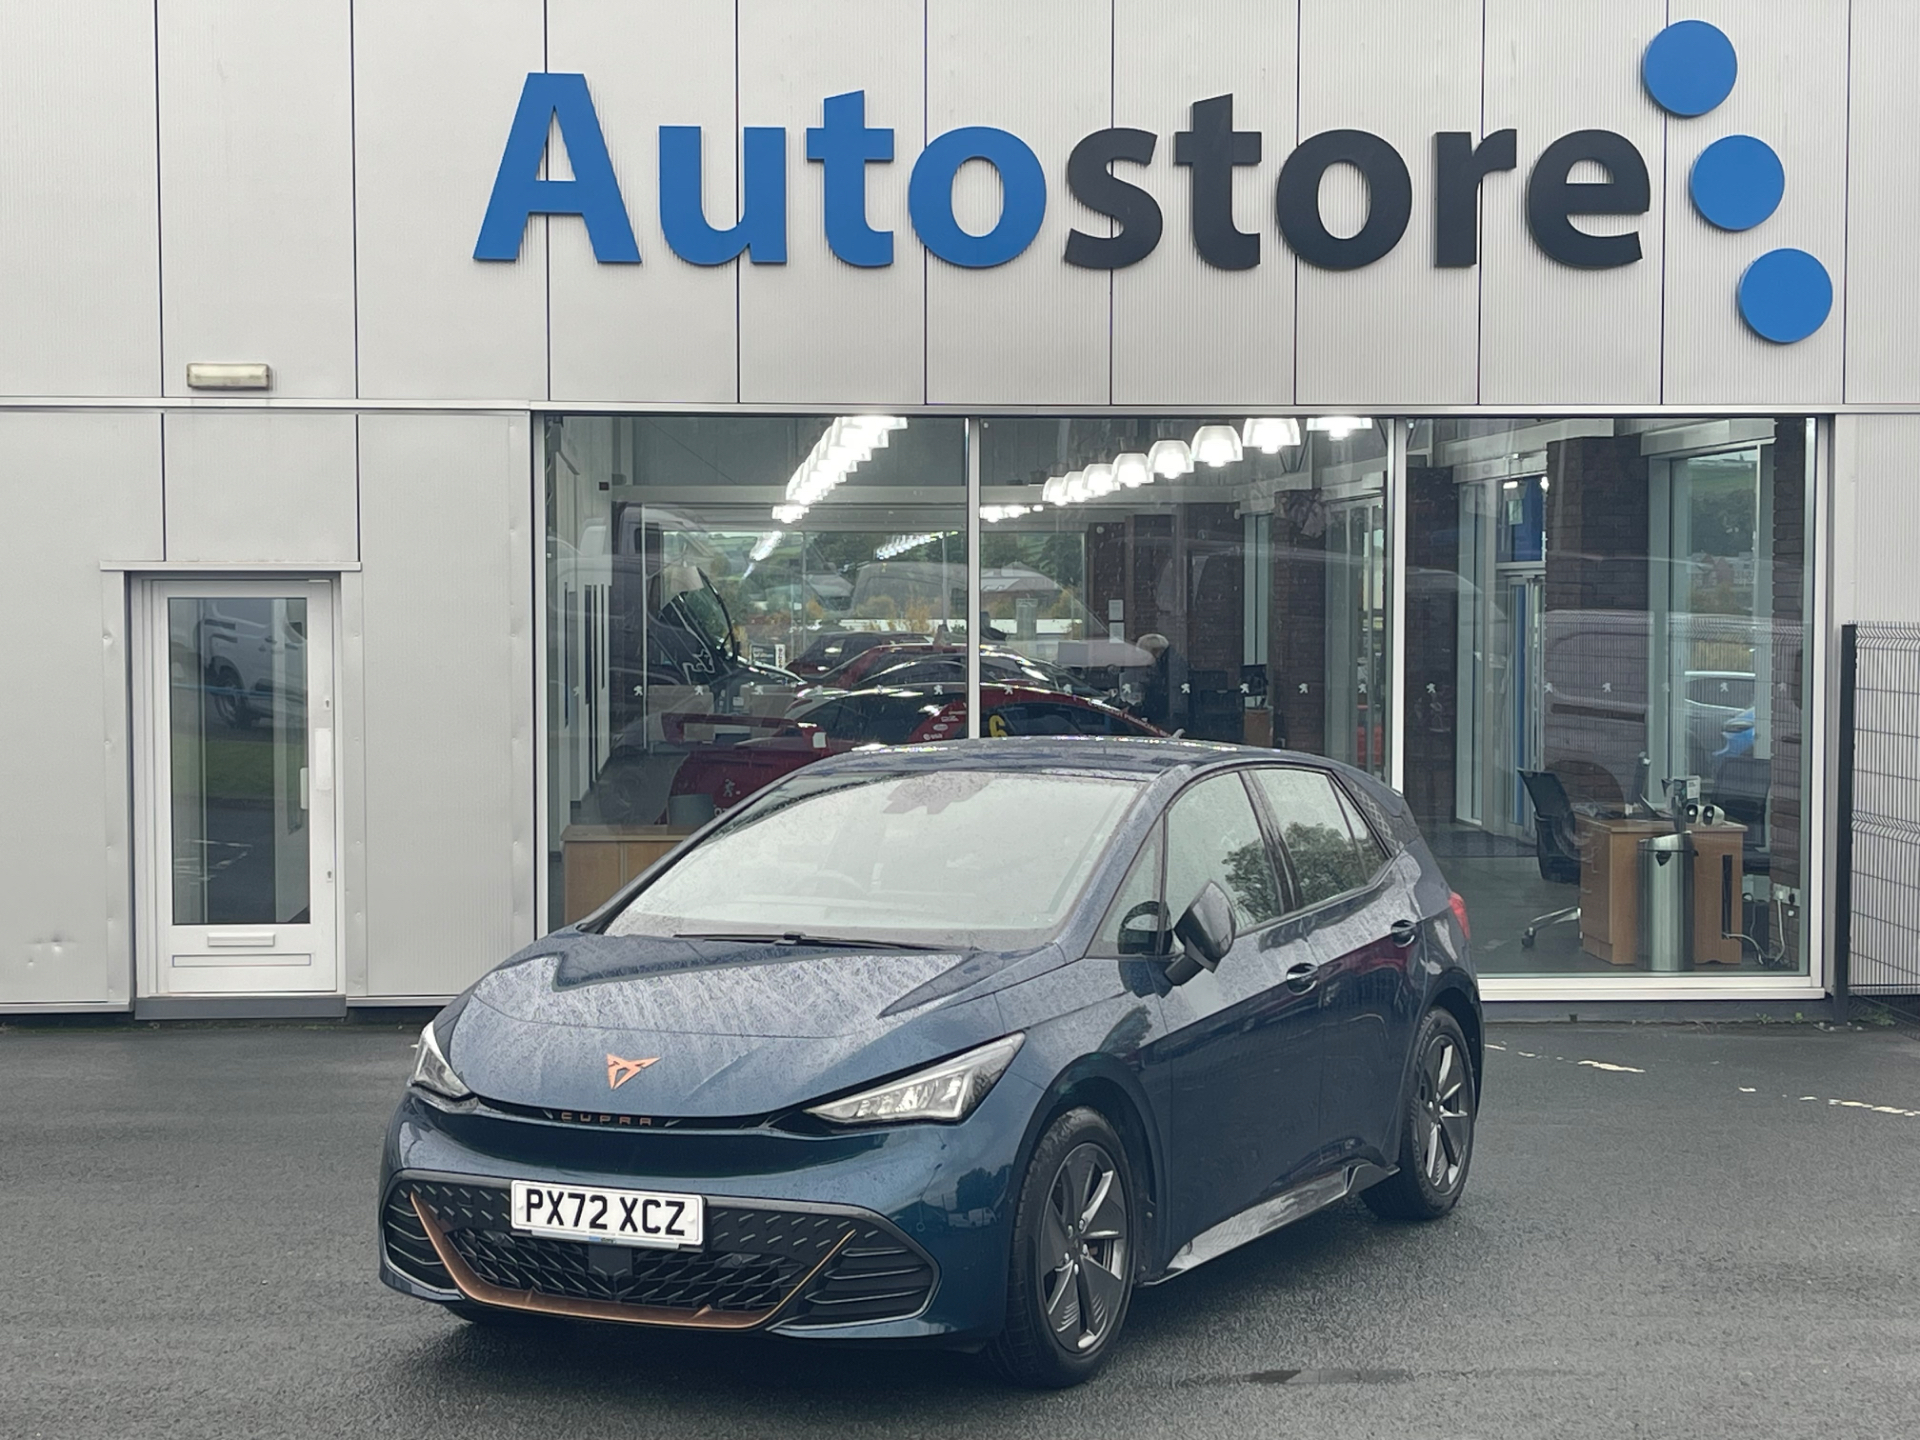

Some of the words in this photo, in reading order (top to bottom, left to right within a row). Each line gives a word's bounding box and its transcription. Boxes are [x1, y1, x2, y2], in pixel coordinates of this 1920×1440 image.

[473, 72, 1651, 271] Autostore
[560, 1111, 652, 1127] CUPRA
[525, 1188, 608, 1231] PX72
[619, 1196, 686, 1237] XCZ
